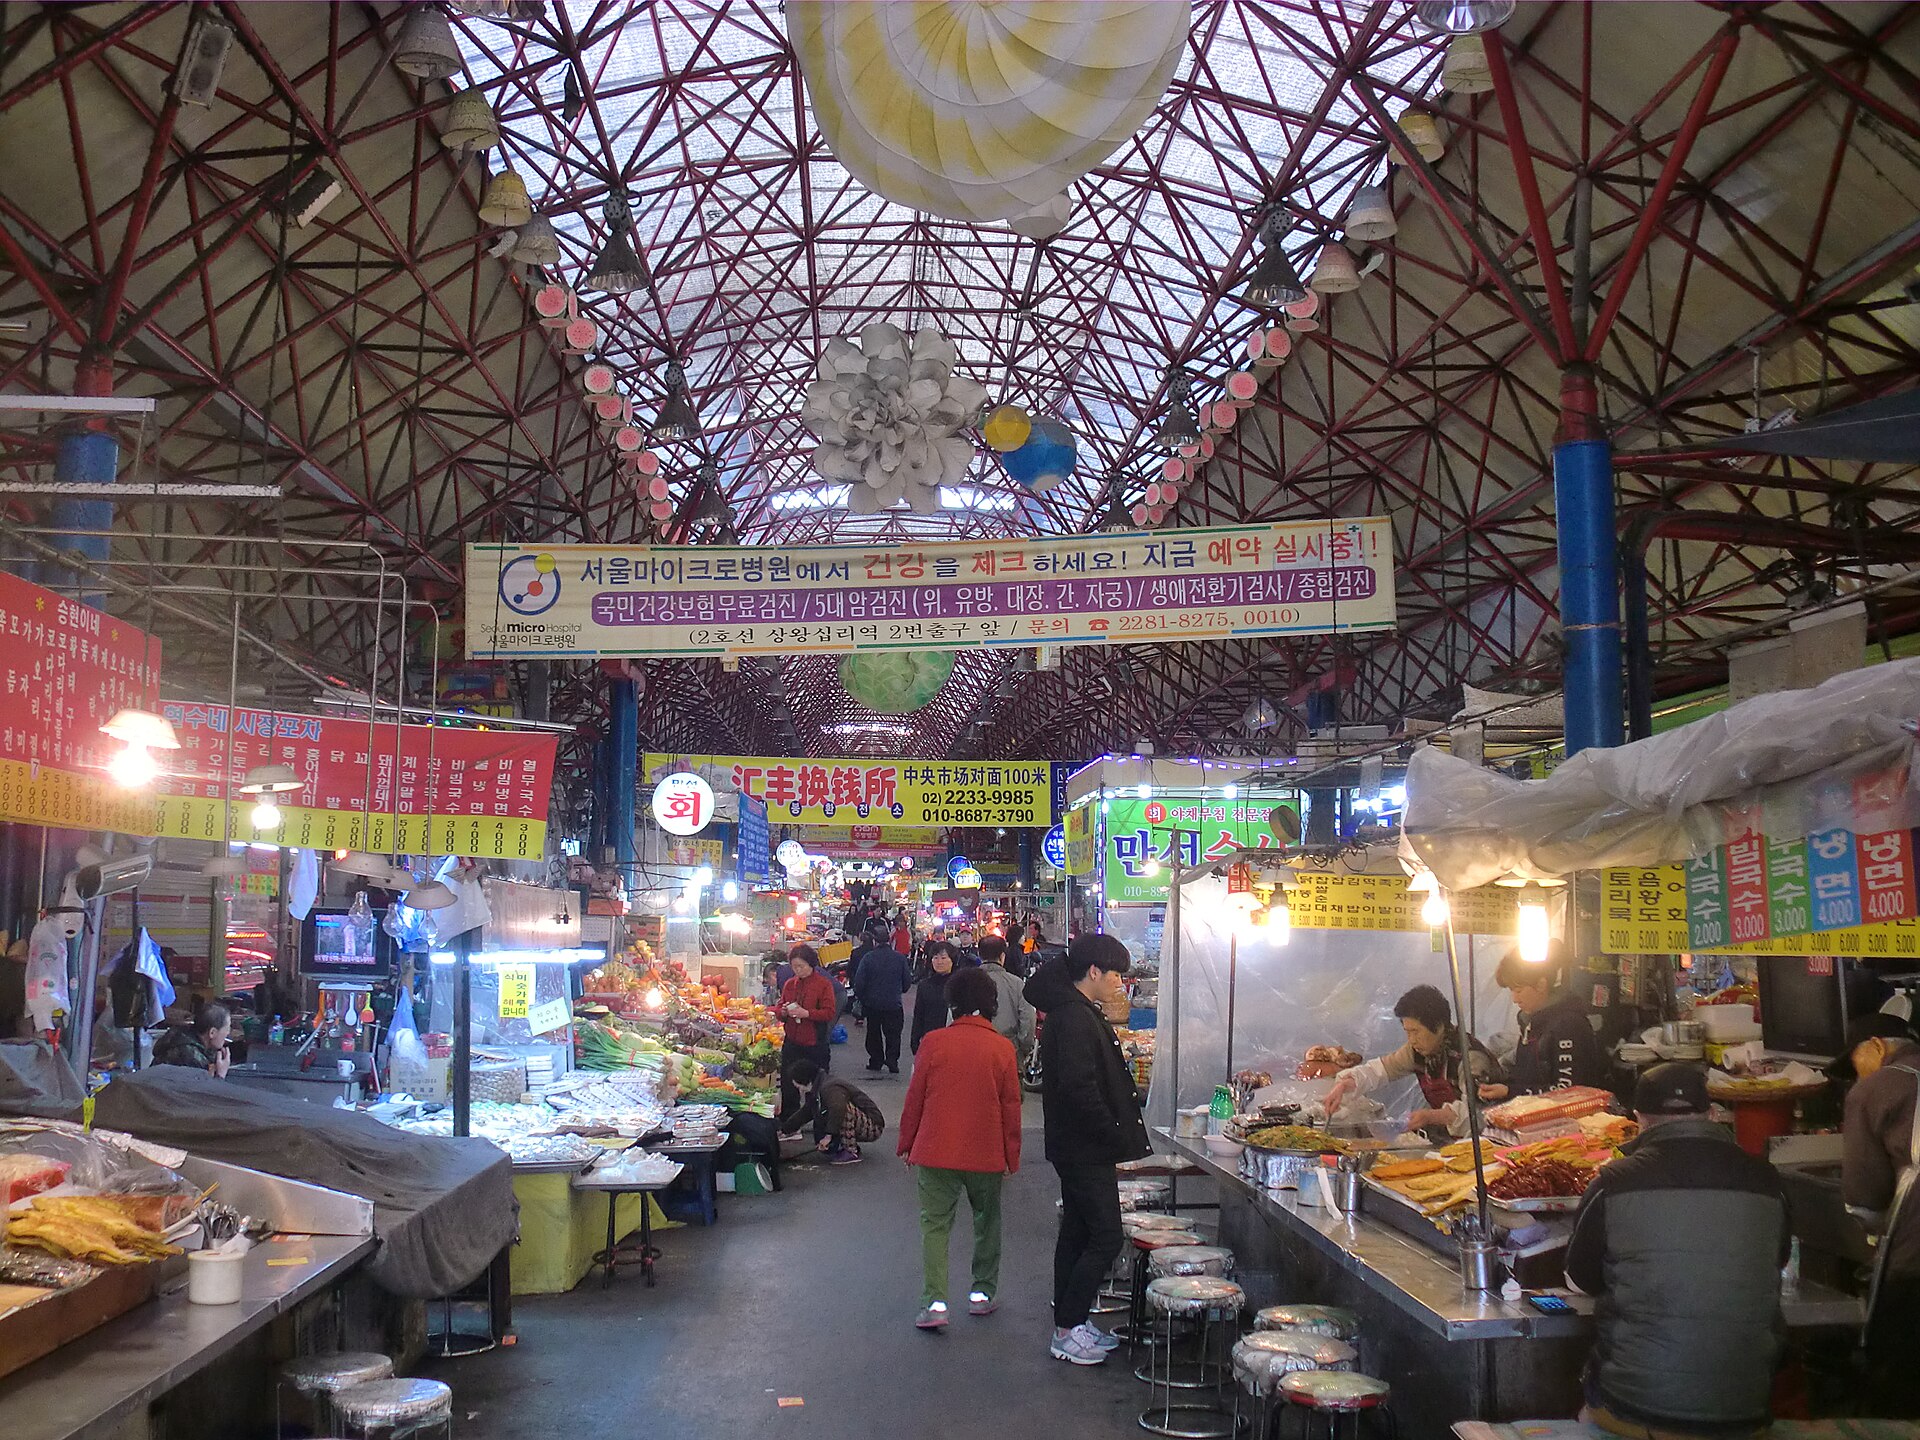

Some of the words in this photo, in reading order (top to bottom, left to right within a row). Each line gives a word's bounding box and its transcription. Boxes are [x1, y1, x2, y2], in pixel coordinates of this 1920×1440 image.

[1144, 540, 1198, 569] 지금
[1207, 536, 1262, 566] 예약
[1274, 530, 1377, 564] 실시중!!
[57, 599, 101, 637] 승현이네
[507, 622, 546, 633] micro
[689, 628, 755, 645] (2호선
[767, 623, 878, 644] 상왕십리역
[889, 620, 971, 641] 2번출구
[980, 621, 1001, 639] 앞
[1027, 618, 1070, 636] 문의
[1119, 611, 1236, 632] 2281-8275,
[1243, 608, 1301, 626] 0010)
[487, 634, 576, 649] 서울마이크로병원
[163, 705, 228, 733] 현수네
[235, 712, 323, 742] 시장포차
[206, 737, 225, 797] 가오리찜
[231, 741, 248, 800] 도토리묵
[301, 748, 320, 808] 홍어사시미
[326, 750, 346, 810] 닭발
[374, 753, 393, 812] 돼지껍데기
[400, 756, 417, 814] 계란말이
[903, 765, 1047, 787] 中央市场对面100米
[445, 759, 465, 814] 비빔국수
[494, 758, 513, 816] 비빔냉면
[518, 759, 538, 817] 열무국수
[731, 765, 897, 807] 汇丰换钱所
[922, 792, 942, 806] 02)
[944, 790, 1034, 806] 2233-9985
[663, 791, 701, 827] 회
[922, 808, 1034, 823] 010-8687-3790
[1171, 806, 1226, 822] 야채무침
[1862, 832, 1905, 891] 냉면
[1314, 876, 1328, 913] 찹쌀순대
[1330, 876, 1344, 913] 잡채
[1346, 877, 1360, 914] 김밥
[1818, 898, 1855, 926] 4.000
[1868, 890, 1905, 918] 4.000
[1694, 920, 1722, 946] 2.000
[1734, 913, 1765, 939] 3.000
[1774, 906, 1807, 933] 3.000
